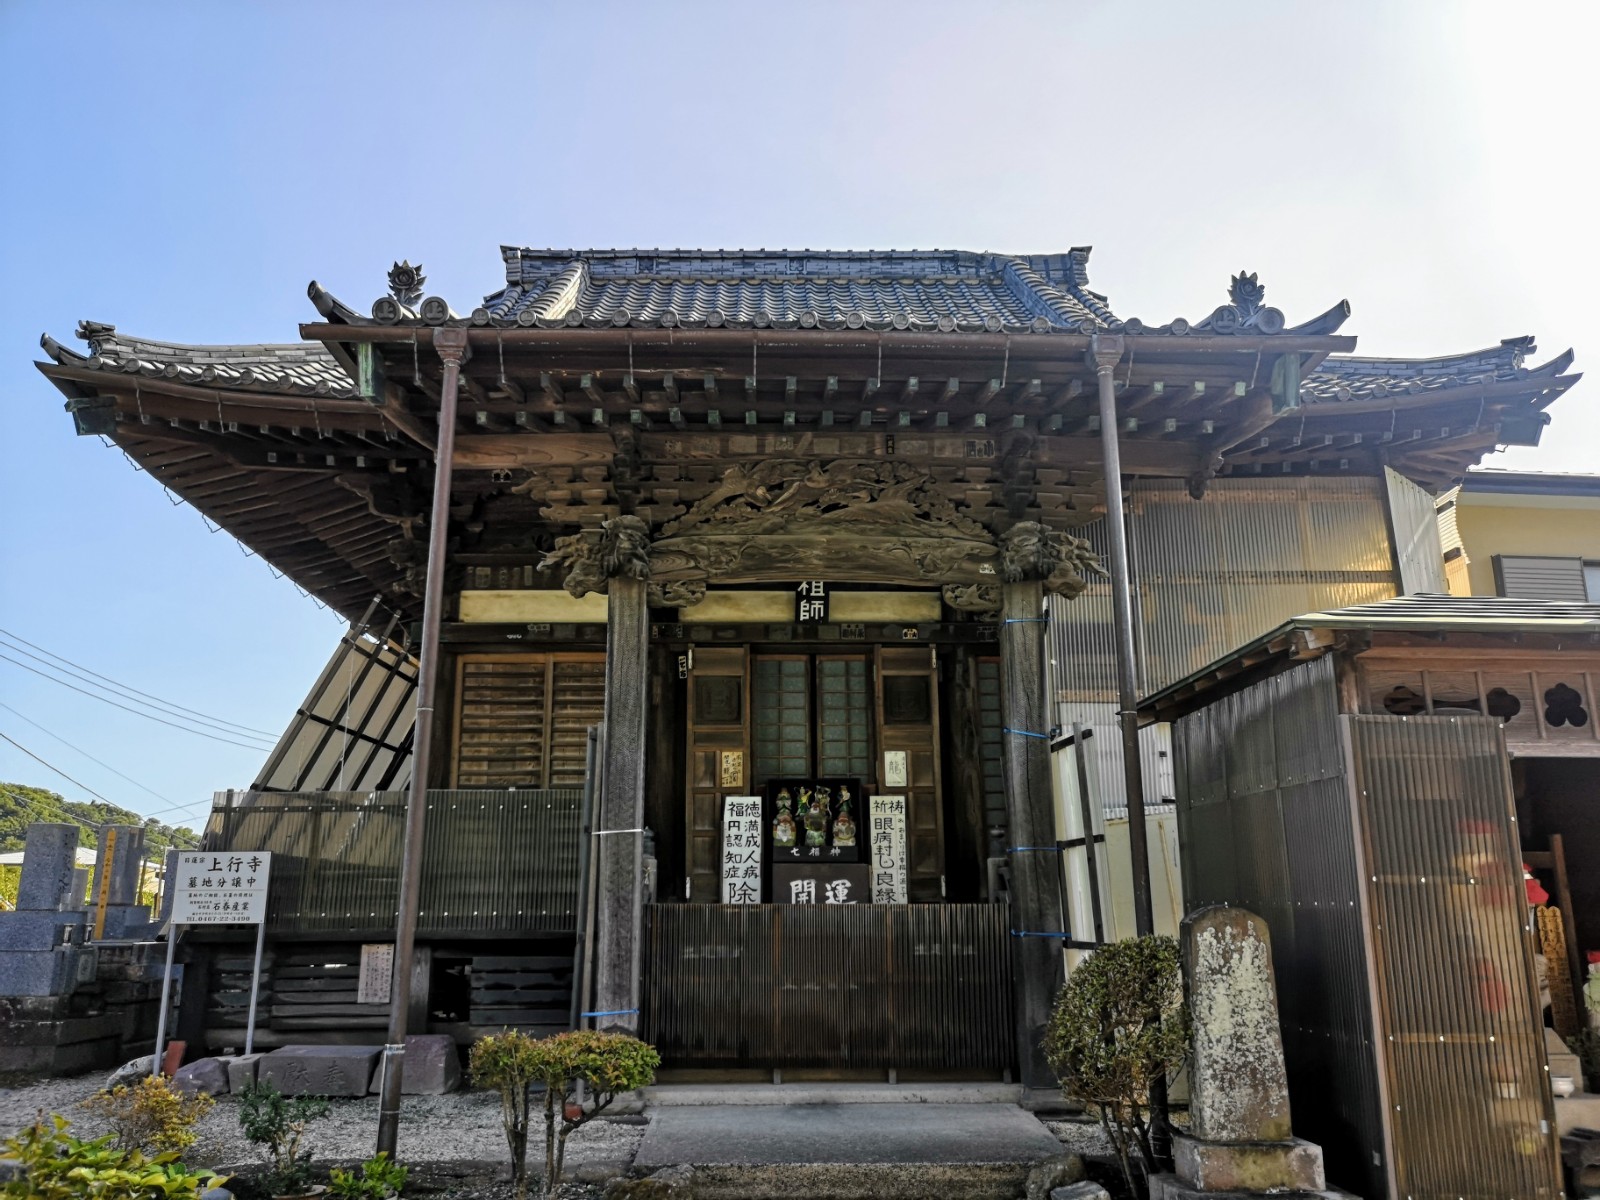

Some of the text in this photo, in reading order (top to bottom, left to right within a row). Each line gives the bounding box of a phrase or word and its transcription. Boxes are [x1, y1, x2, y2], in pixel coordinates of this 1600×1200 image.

[797, 581, 825, 621] 祖師
[790, 847, 841, 857] 七福神
[207, 856, 262, 873] 上行寺
[187, 876, 257, 888] 墓地分譲中
